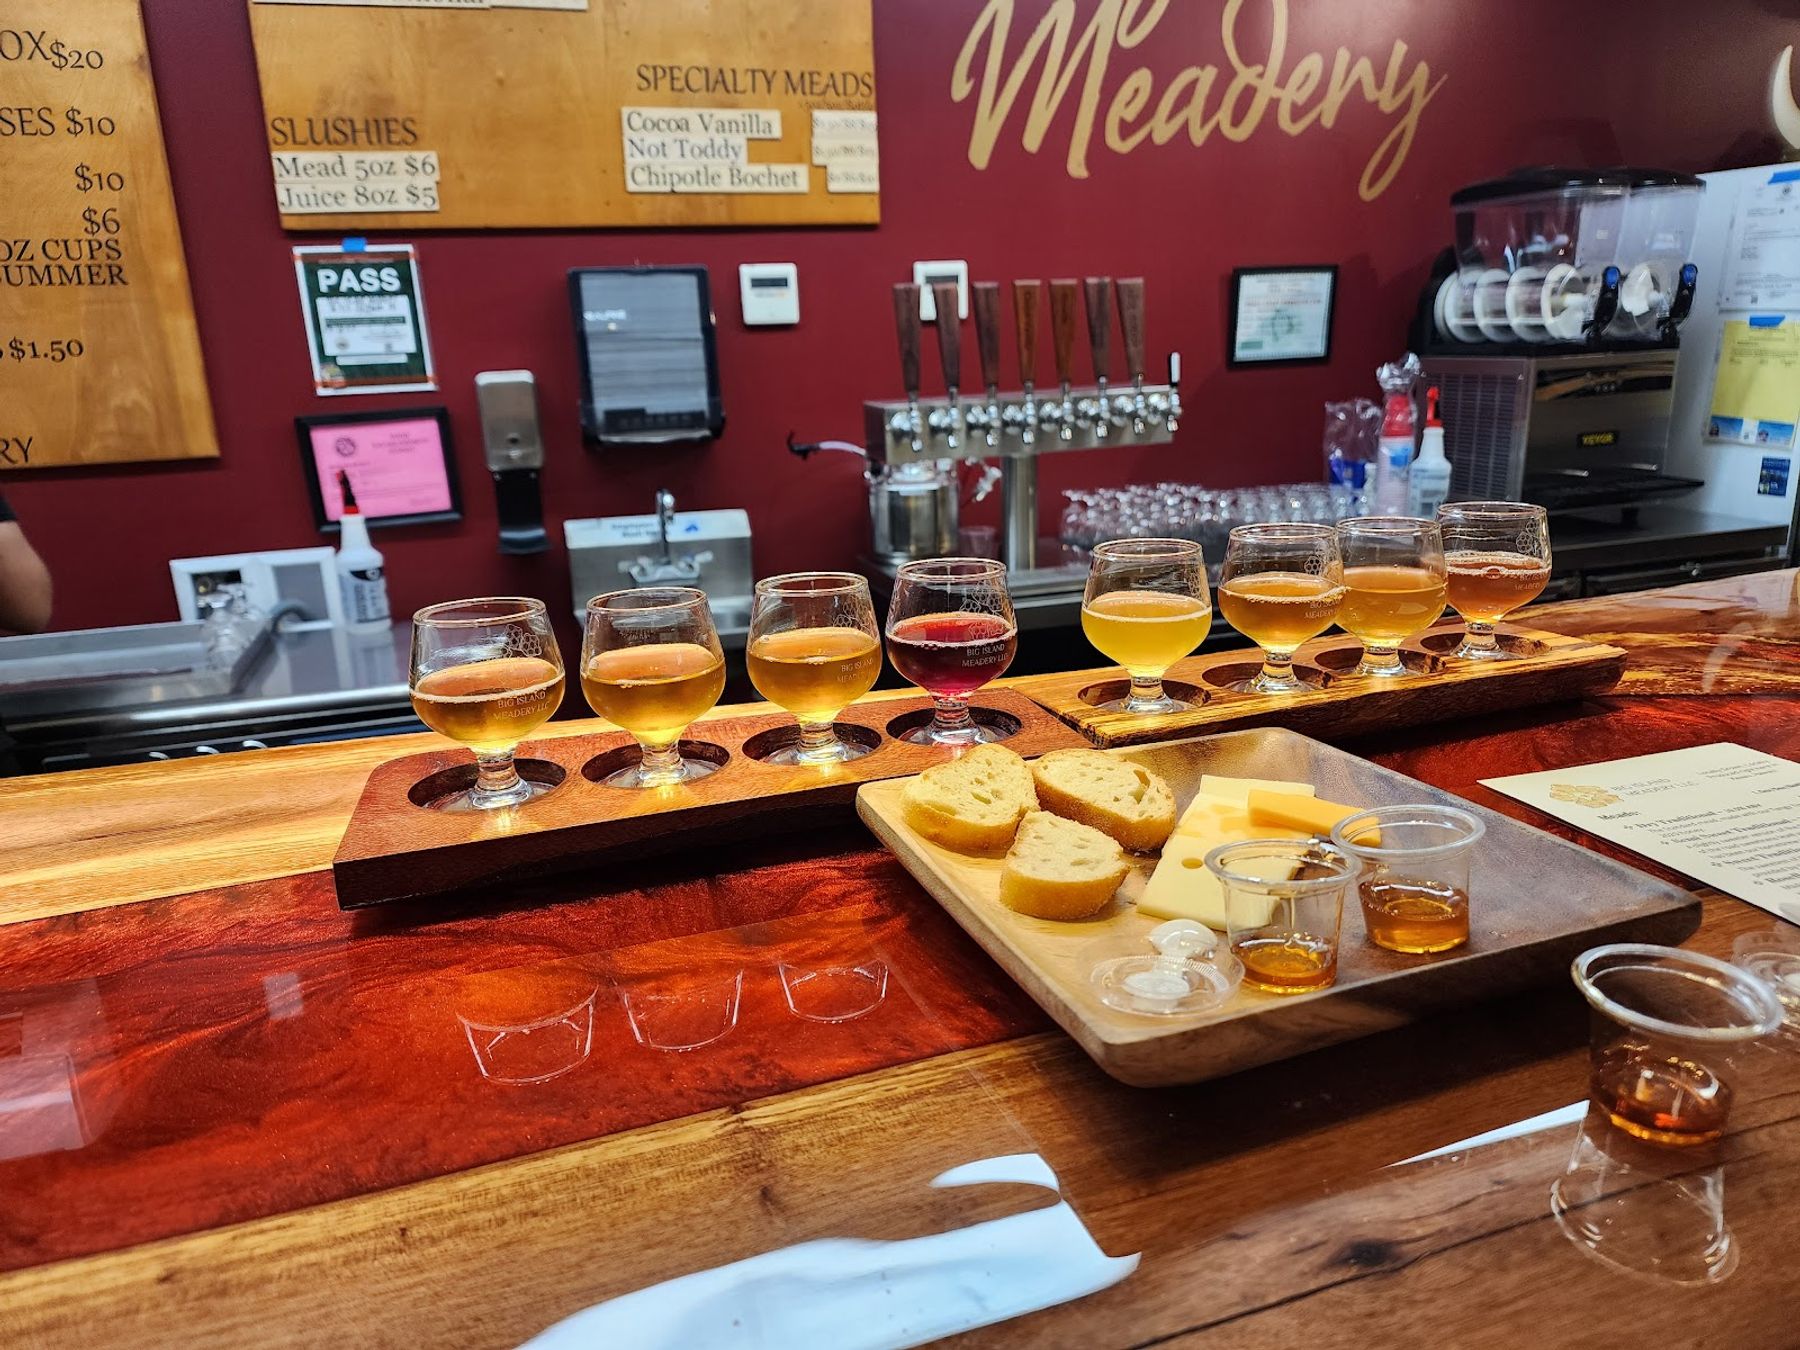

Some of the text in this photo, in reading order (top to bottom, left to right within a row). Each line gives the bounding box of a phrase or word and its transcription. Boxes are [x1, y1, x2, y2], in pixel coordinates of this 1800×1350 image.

[0, 30, 103, 70] OX $20
[636, 64, 873, 97] SPECIALTY MEADS
[951, 0, 1448, 201] Meadery
[66, 106, 115, 137] $10
[270, 116, 418, 146] SLUSHIES
[627, 111, 773, 135] Cocoa Vanilla
[628, 138, 743, 162] Not Toddy
[75, 163, 124, 192] $10
[275, 153, 436, 181] Mead 5oz $6
[630, 163, 798, 188] Chipotle Bochet
[279, 184, 436, 208] Juice 8oz $5
[82, 207, 120, 236] $6
[41, 238, 122, 262] CUPS
[0, 264, 129, 287] UMMER
[317, 267, 401, 293] PASS
[10, 337, 84, 362] $1.50
[982, 643, 1005, 655] ISLAND
[493, 705, 536, 720] MEADERY
[497, 691, 546, 709] BIG ISLAND
